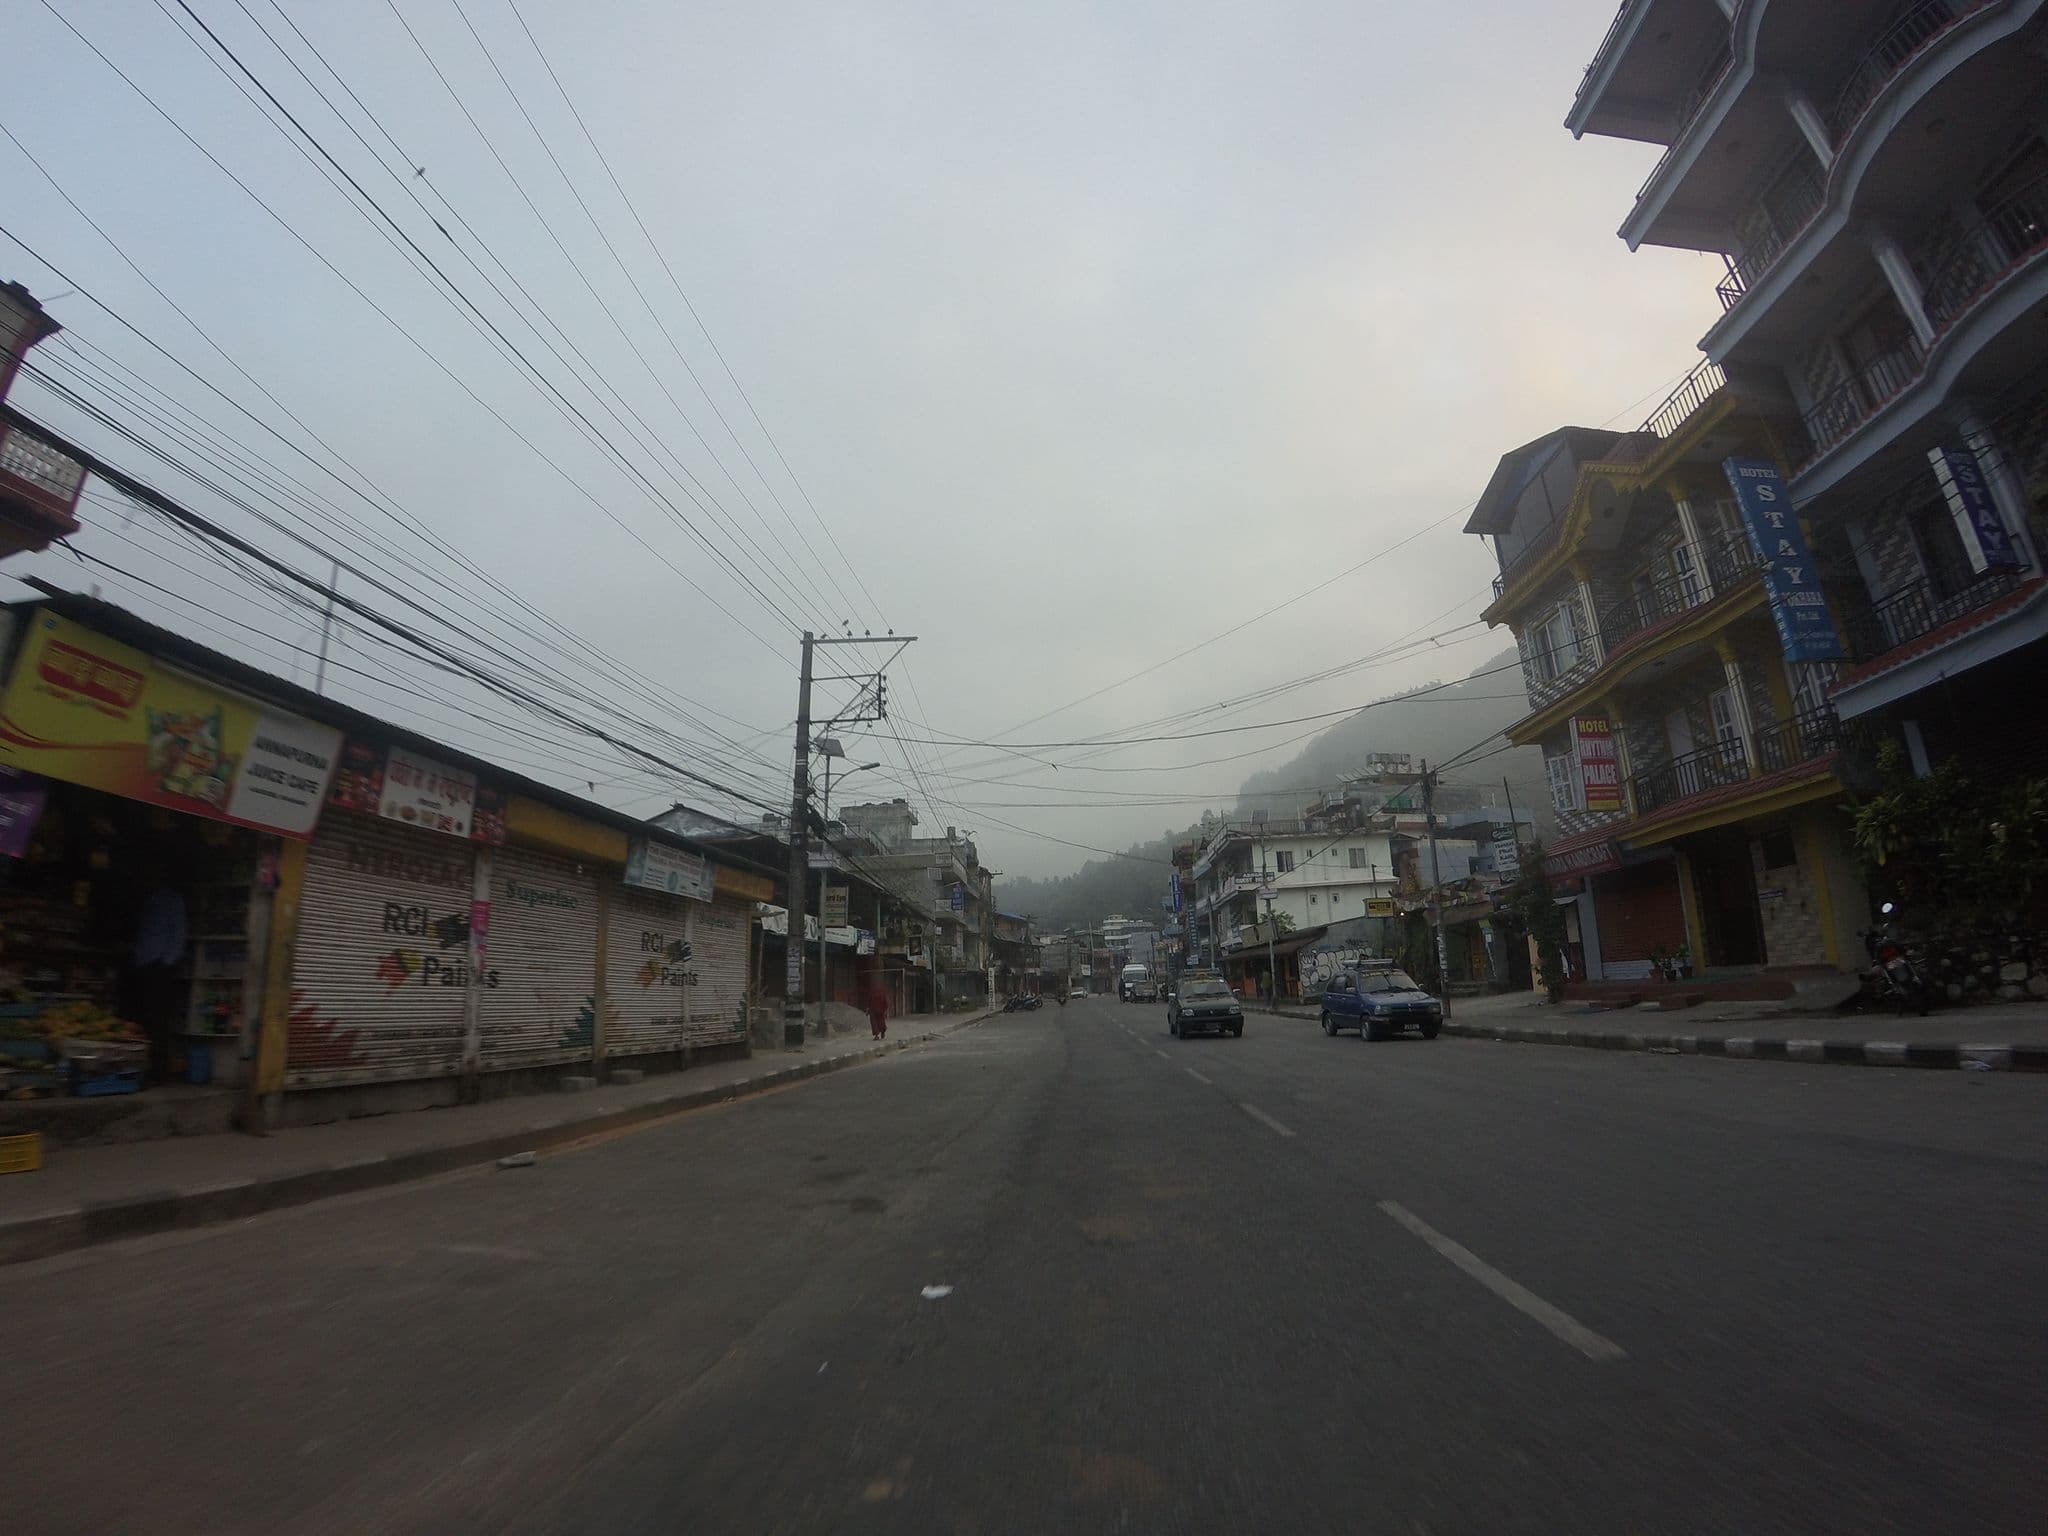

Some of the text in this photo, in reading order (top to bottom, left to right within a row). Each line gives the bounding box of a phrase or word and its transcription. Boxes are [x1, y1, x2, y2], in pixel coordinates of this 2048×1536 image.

[1739, 467, 1779, 479] HOTEL
[1958, 463, 2002, 552] STAY
[1756, 484, 1804, 585] STAY
[1578, 720, 1609, 733] HOTEL
[247, 762, 319, 794] JUICE CAFE
[1583, 764, 1618, 785] PALACE
[384, 902, 428, 937] RCI
[641, 932, 664, 954] RCI
[661, 966, 699, 987] Paints
